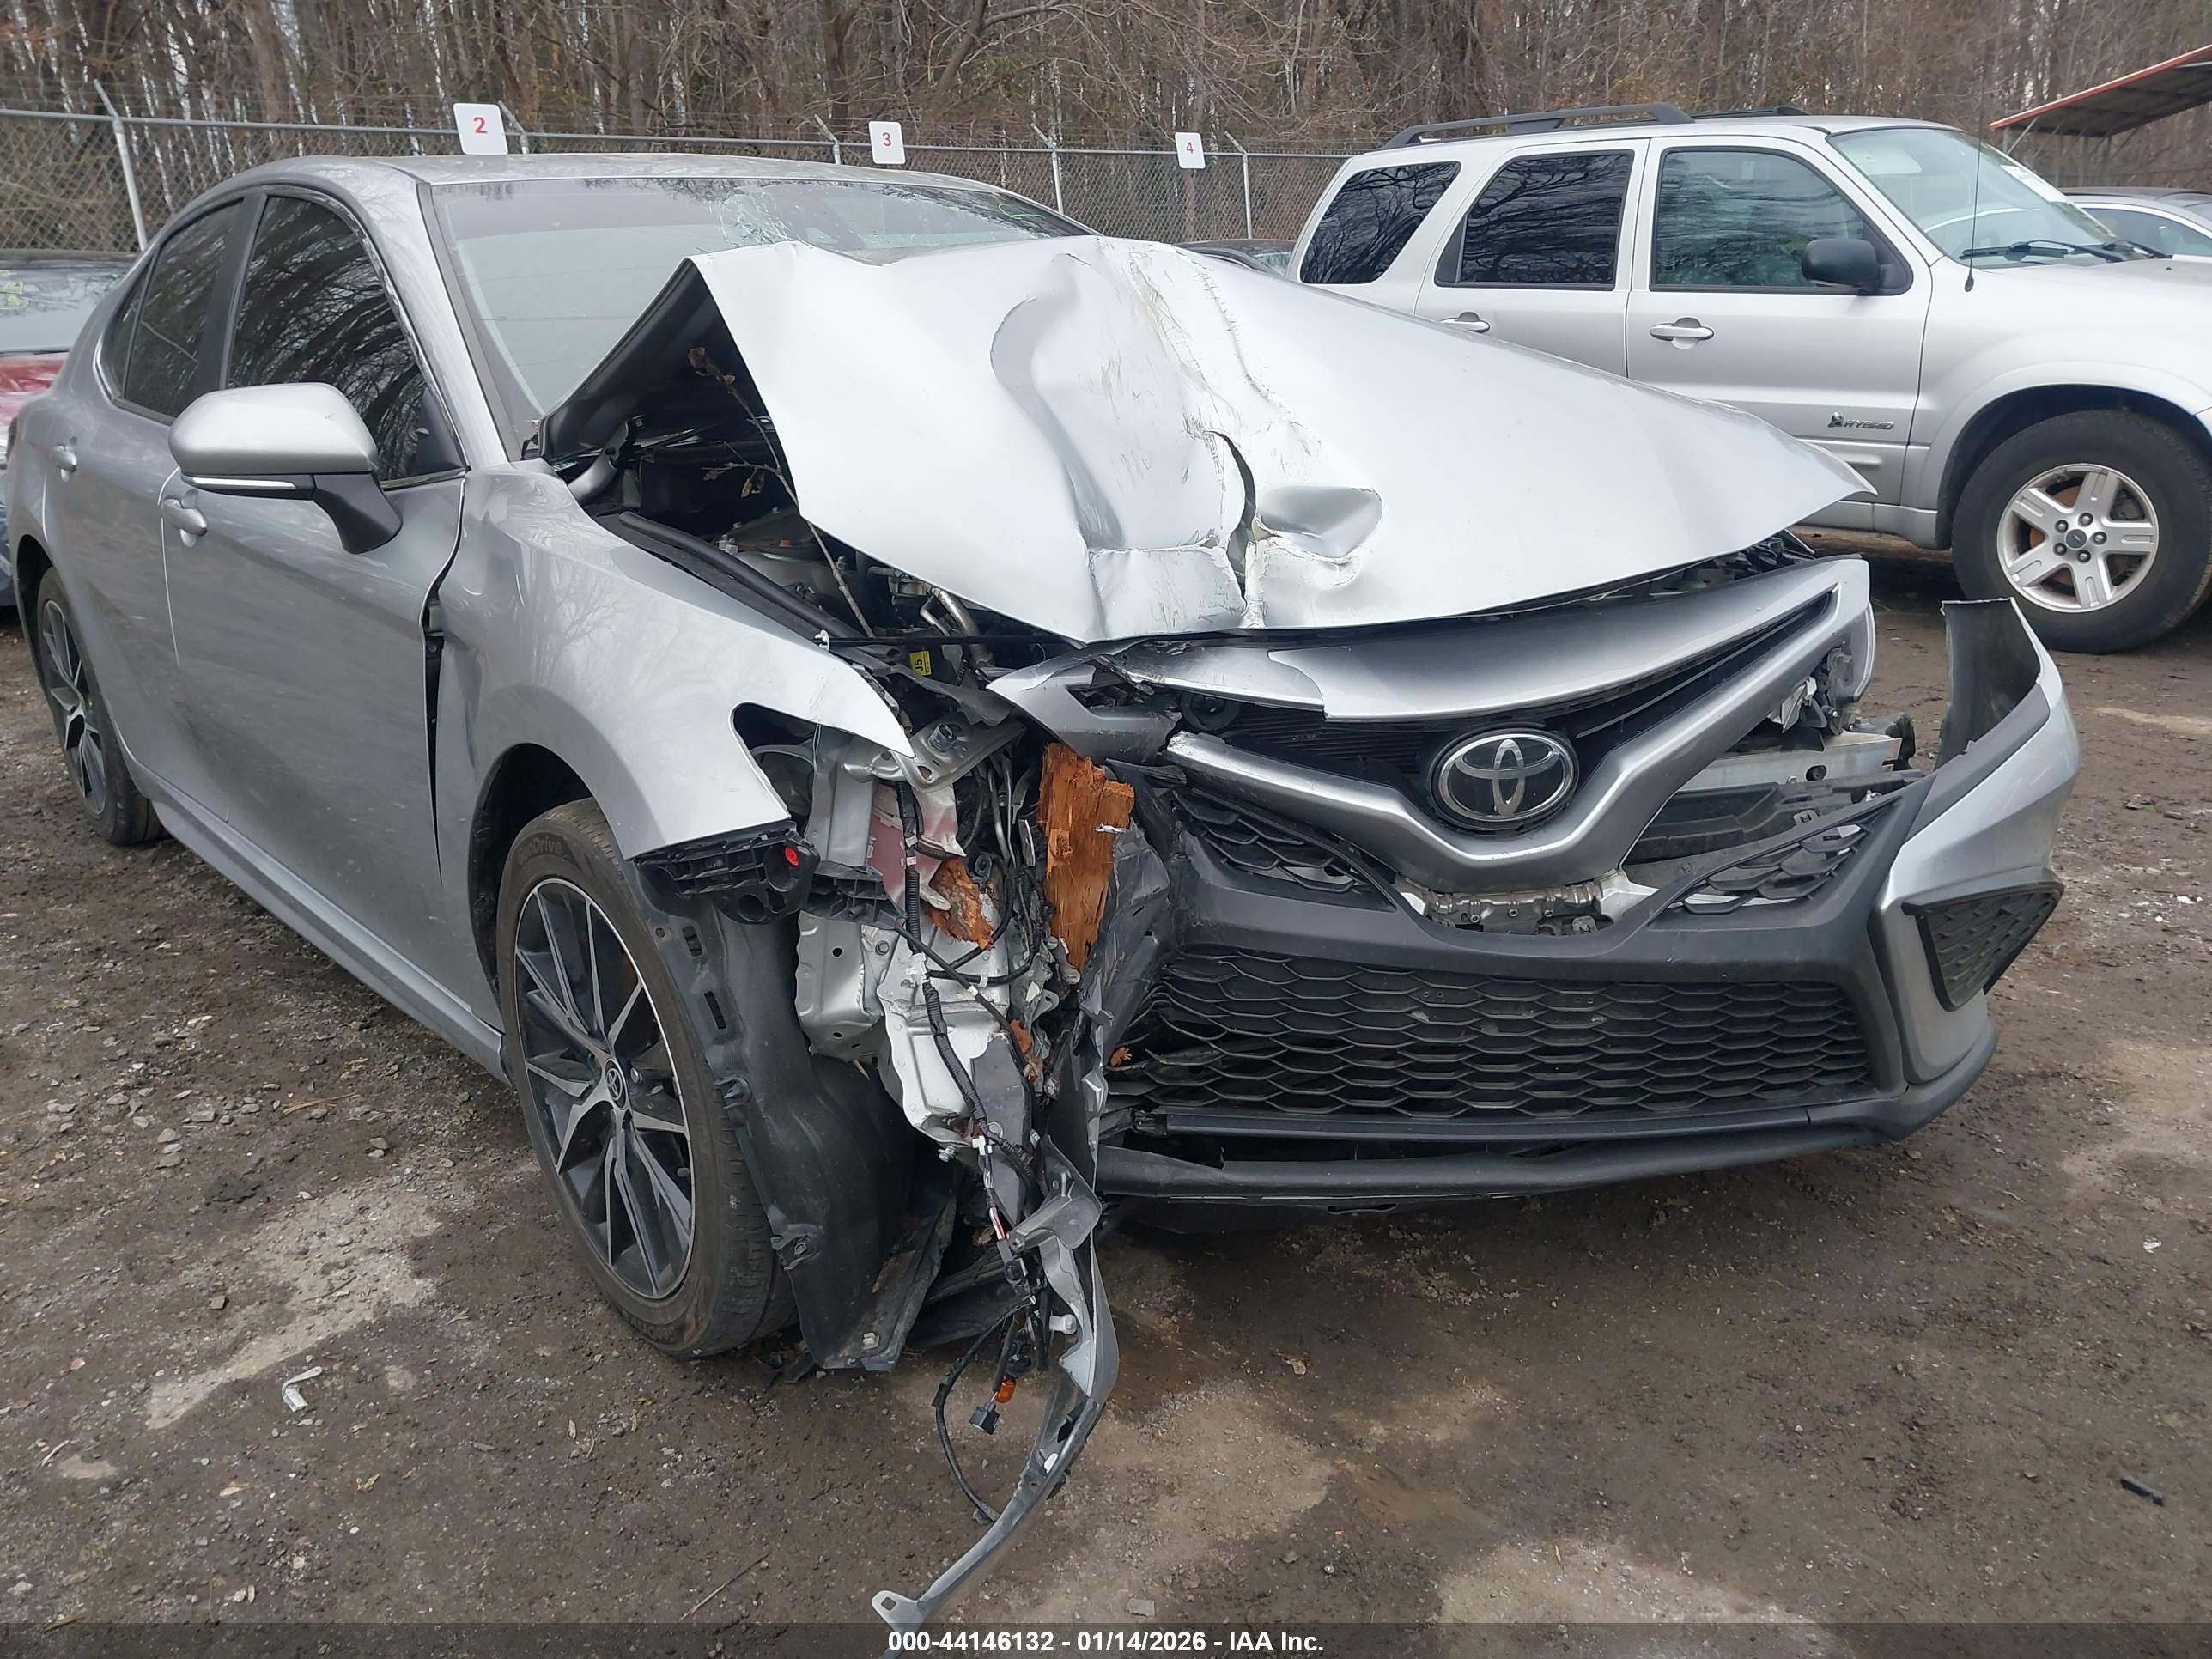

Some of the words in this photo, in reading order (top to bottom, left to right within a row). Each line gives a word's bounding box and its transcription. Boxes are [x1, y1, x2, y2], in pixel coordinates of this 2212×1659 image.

[473, 116, 488, 134] 2
[882, 131, 892, 147] 3
[1186, 141, 1194, 155] 4
[1844, 419, 1895, 430] HYBRID
